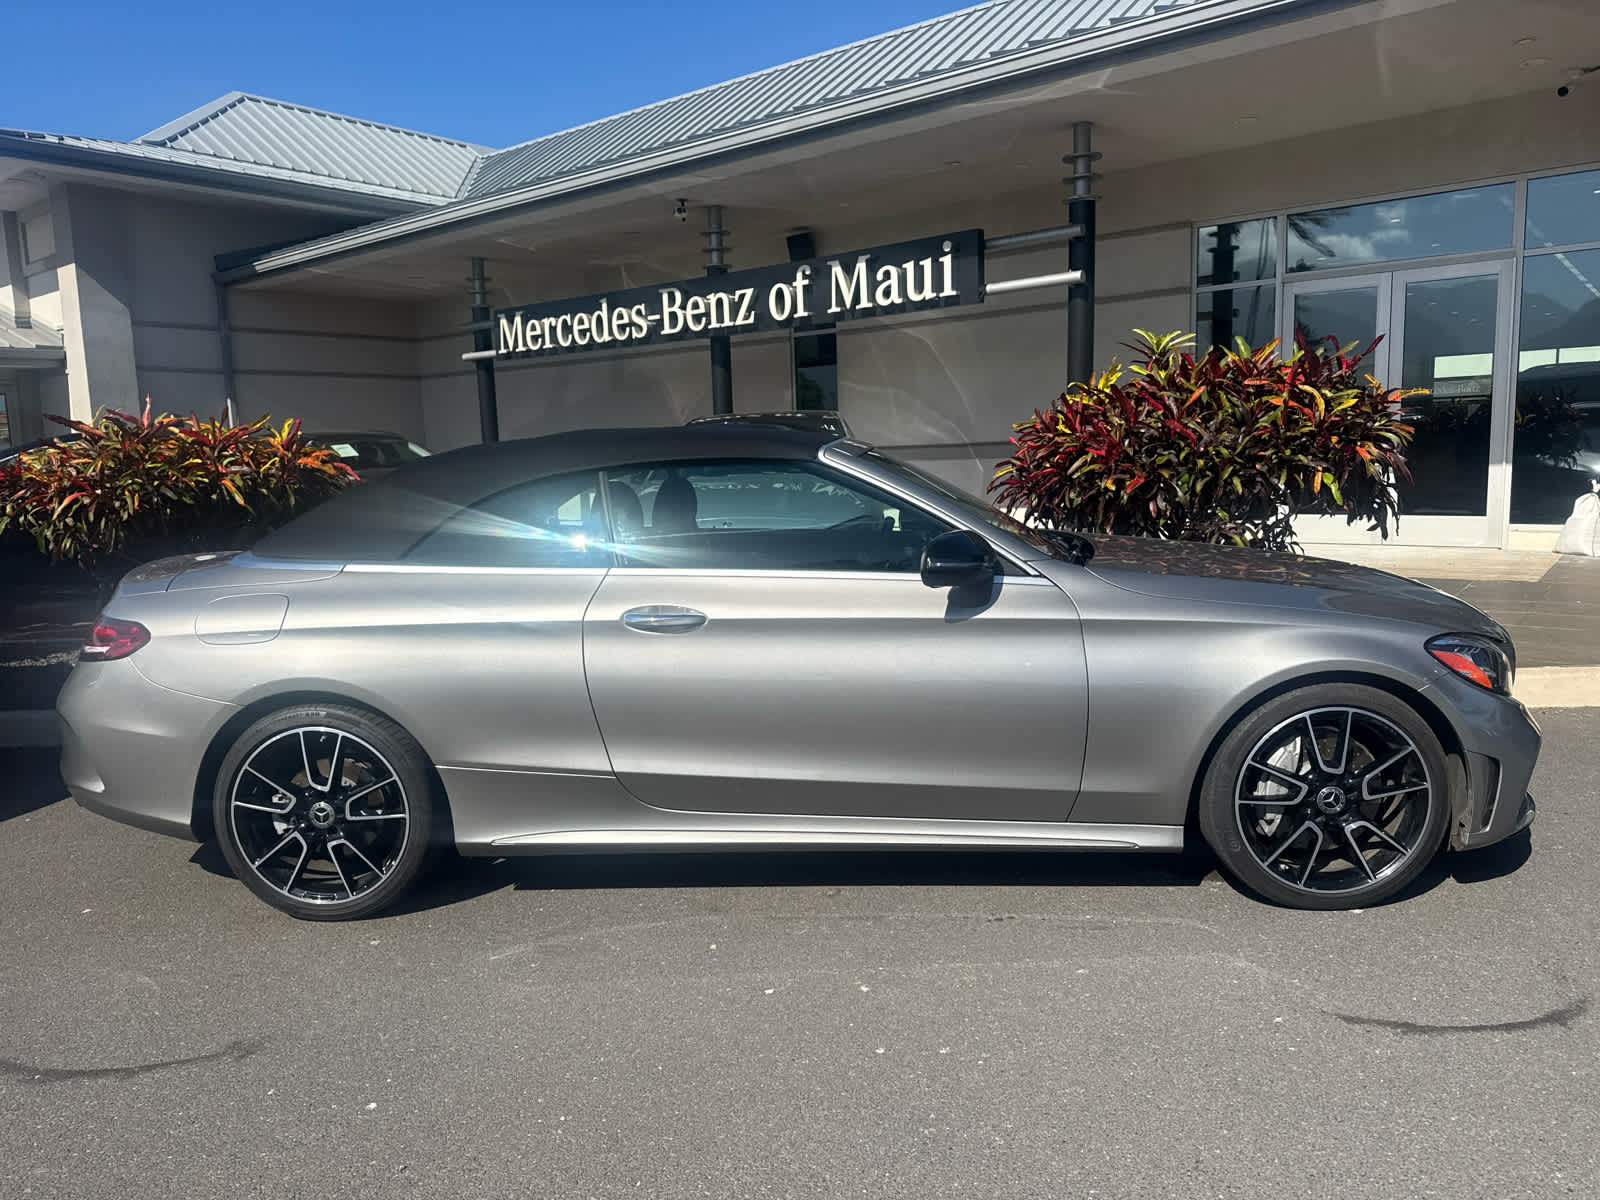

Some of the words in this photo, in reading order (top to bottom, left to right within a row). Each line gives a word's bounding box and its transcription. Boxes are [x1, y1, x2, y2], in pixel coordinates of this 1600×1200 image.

[498, 287, 755, 354] Mercedes-Benz
[768, 264, 811, 321] of
[827, 240, 959, 314] Maui
